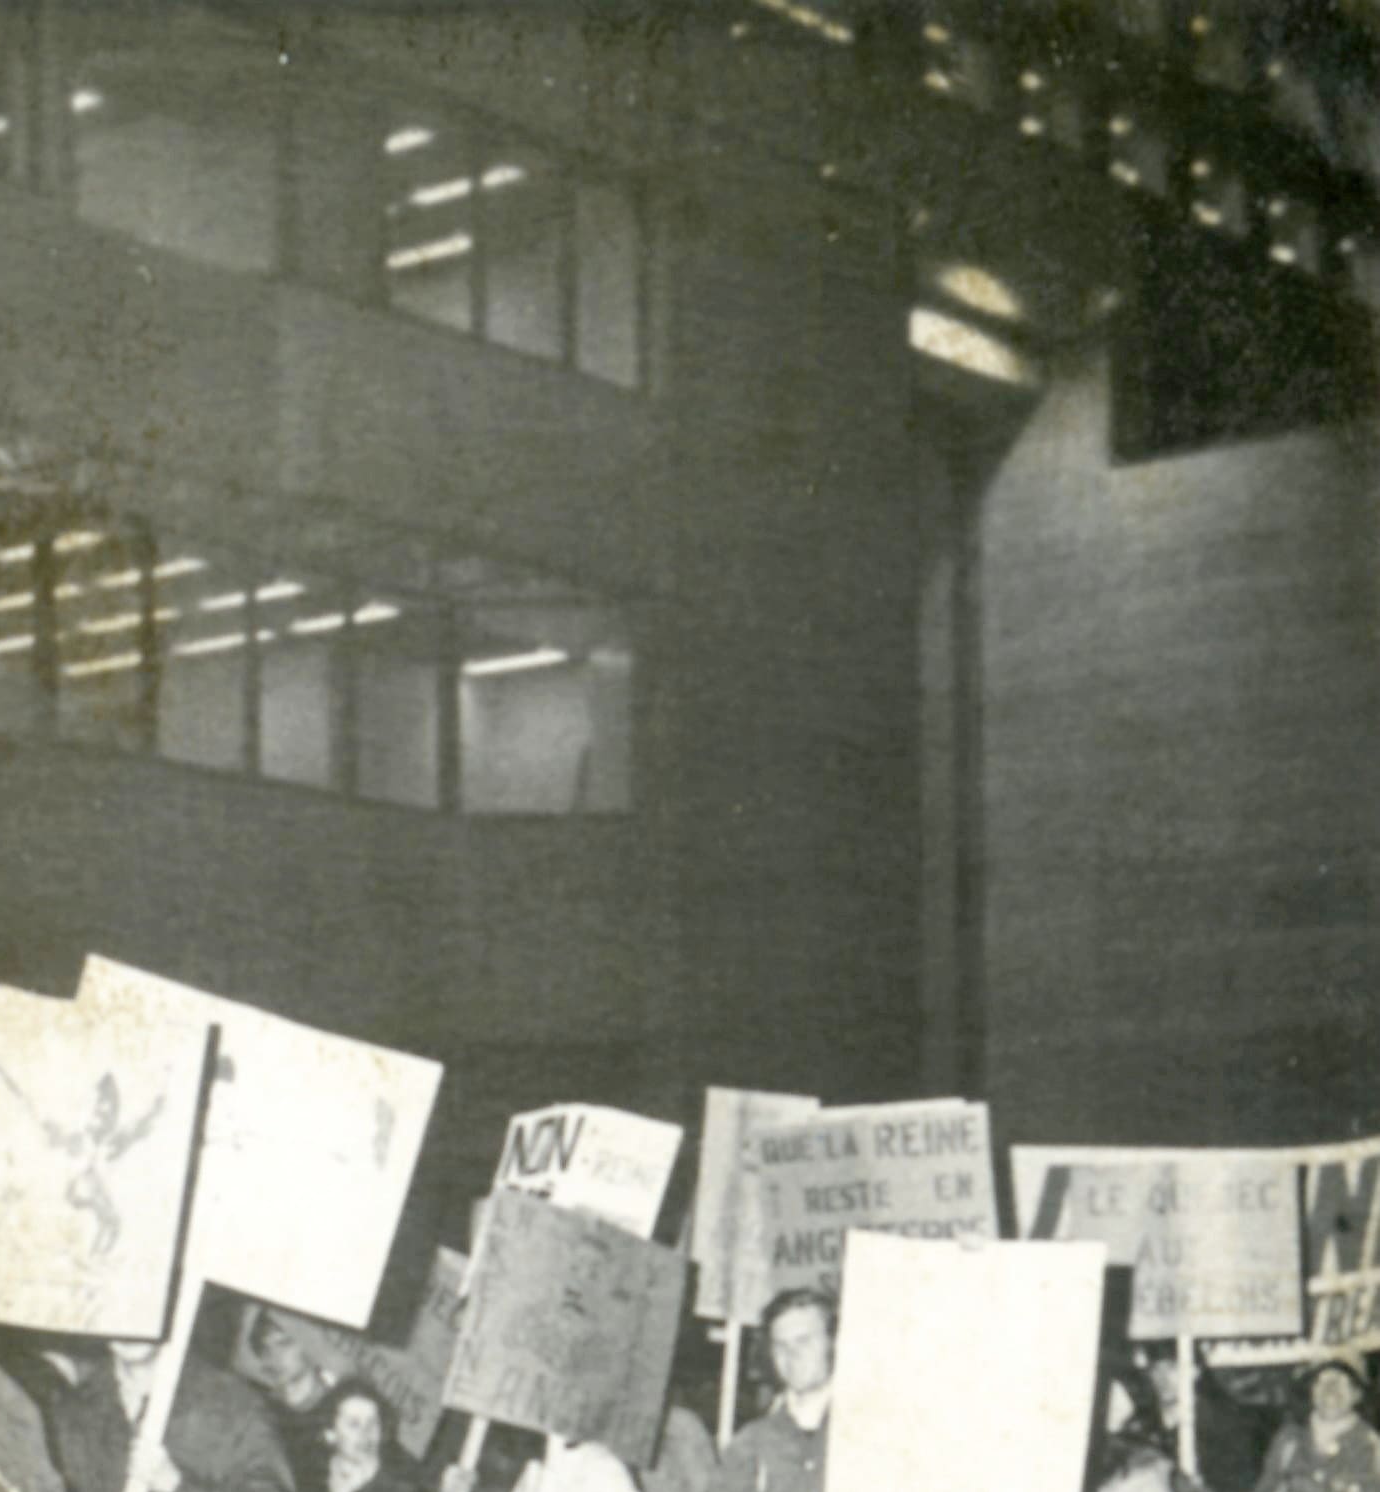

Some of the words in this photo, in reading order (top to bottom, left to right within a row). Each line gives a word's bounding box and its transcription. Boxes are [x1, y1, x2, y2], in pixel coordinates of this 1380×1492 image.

[501, 1114, 588, 1177] NON
[873, 1114, 981, 1159] REINE
[803, 1180, 892, 1214] RESTE
[933, 1171, 974, 1202] EN
